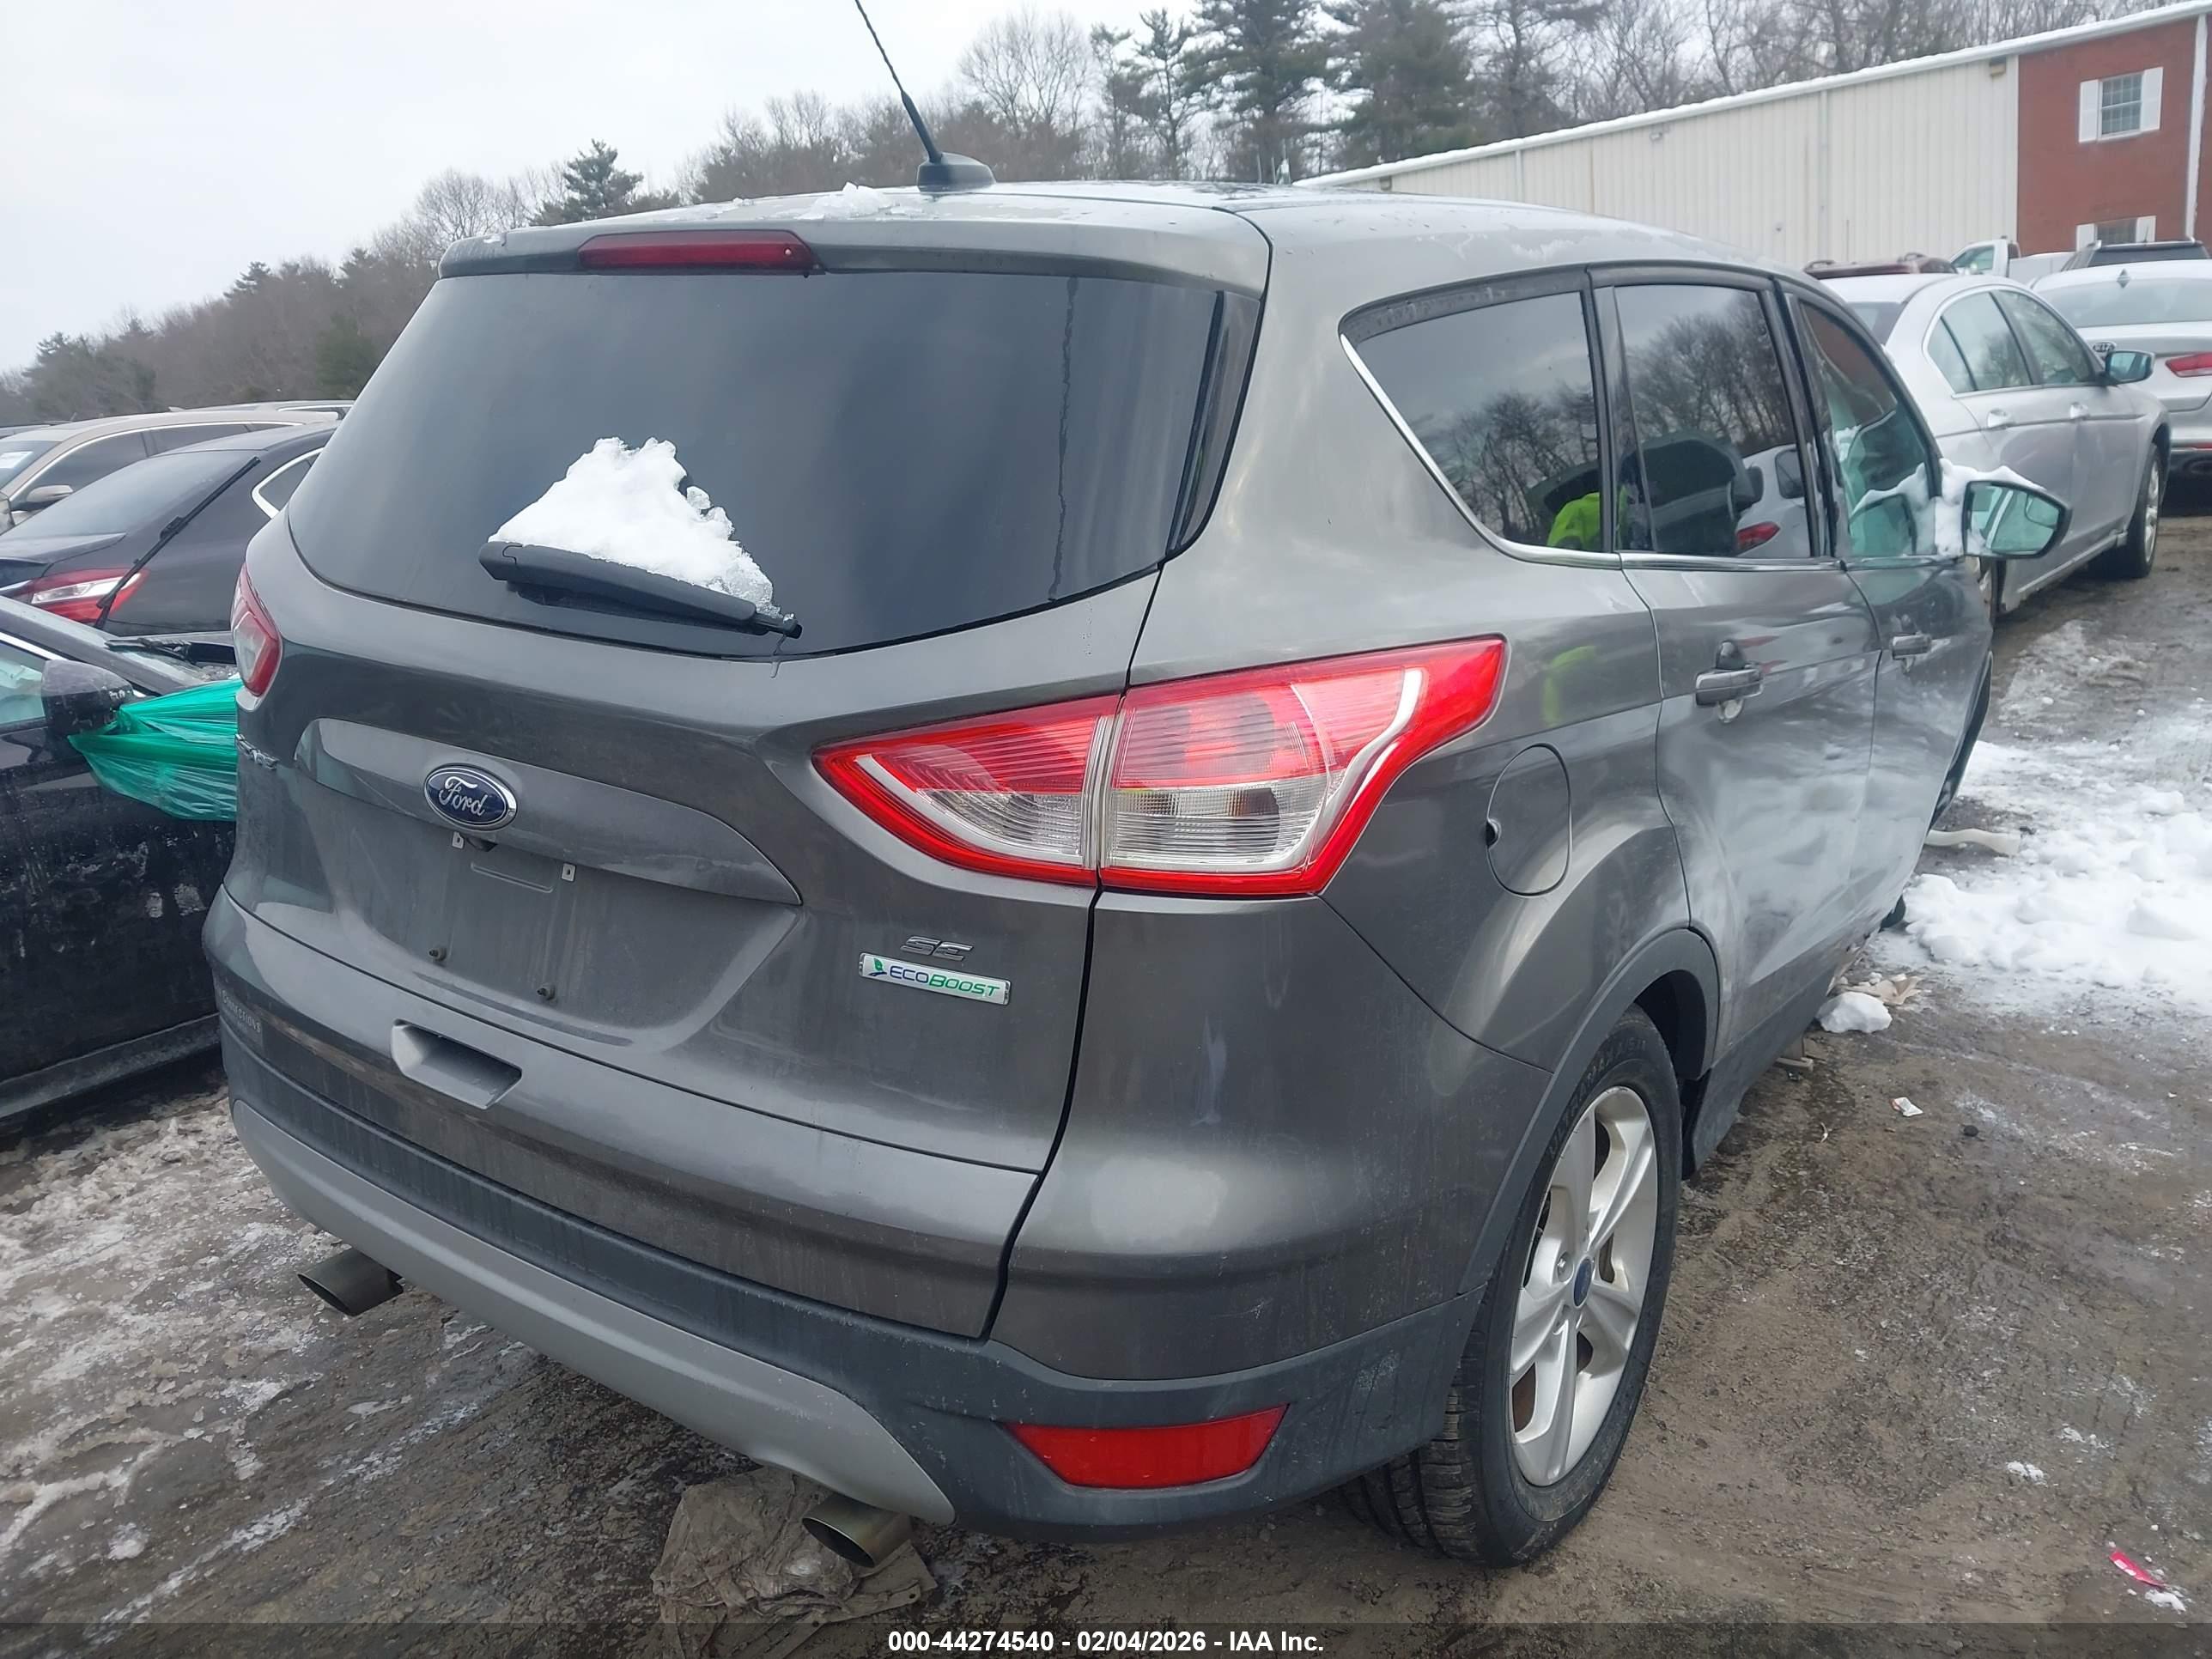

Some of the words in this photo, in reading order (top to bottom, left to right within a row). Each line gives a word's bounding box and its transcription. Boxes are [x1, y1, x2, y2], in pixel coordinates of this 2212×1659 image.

[439, 776, 488, 817] Ford
[901, 936, 974, 962] SE
[890, 965, 1000, 997] ECOBOOST
